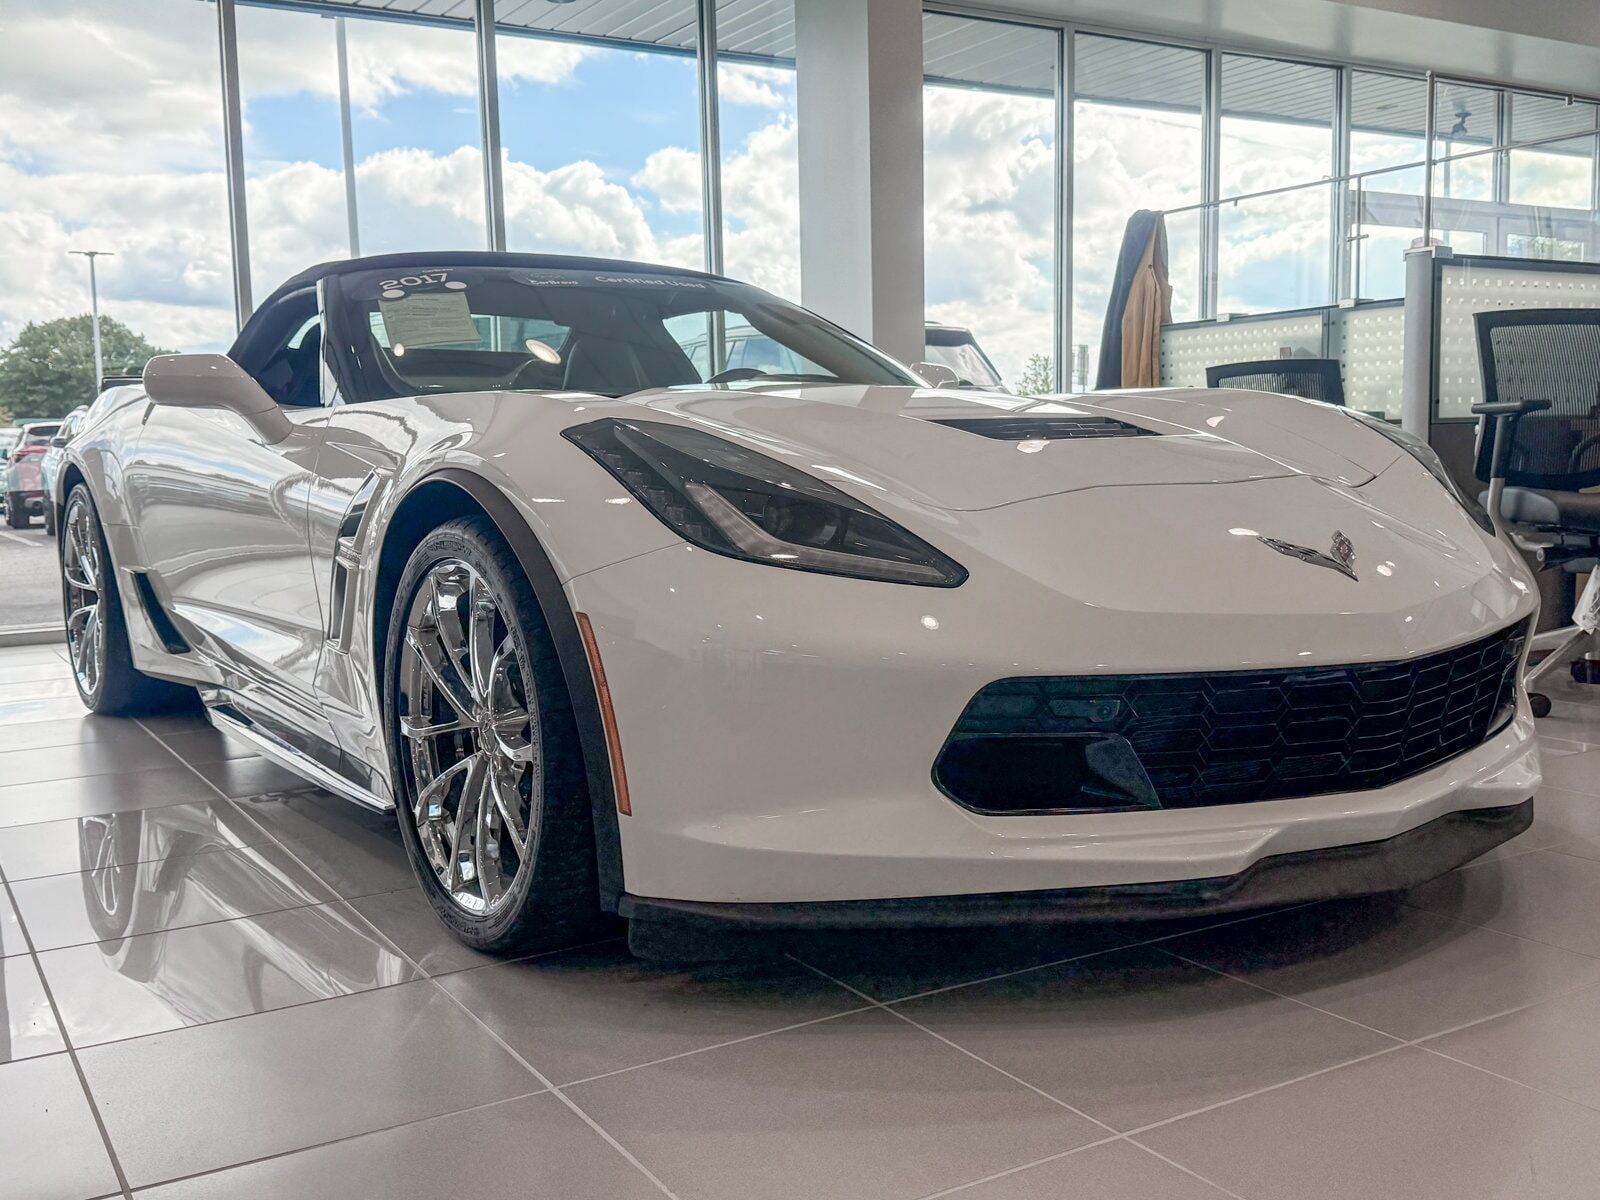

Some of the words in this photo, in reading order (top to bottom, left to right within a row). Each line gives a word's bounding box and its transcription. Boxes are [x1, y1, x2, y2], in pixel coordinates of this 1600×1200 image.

[379, 272, 447, 290] 2017
[594, 275, 664, 285] Certified
[665, 280, 706, 289] Used
